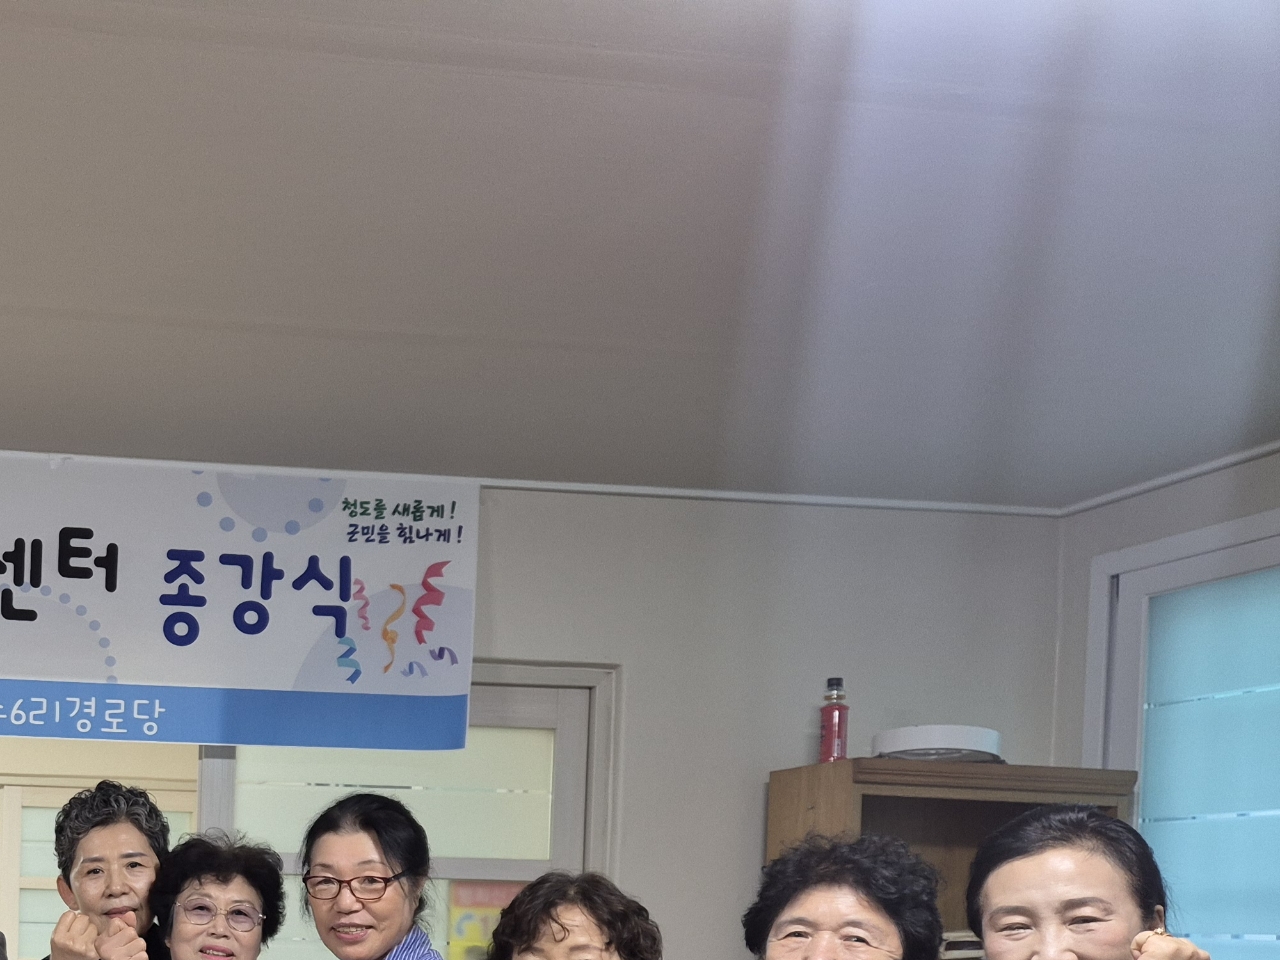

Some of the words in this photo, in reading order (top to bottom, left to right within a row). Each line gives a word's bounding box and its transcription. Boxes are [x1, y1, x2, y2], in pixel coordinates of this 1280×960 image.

[341, 497, 388, 520] 청도를
[346, 523, 391, 544] 군민을
[158, 547, 354, 647] 종강식
